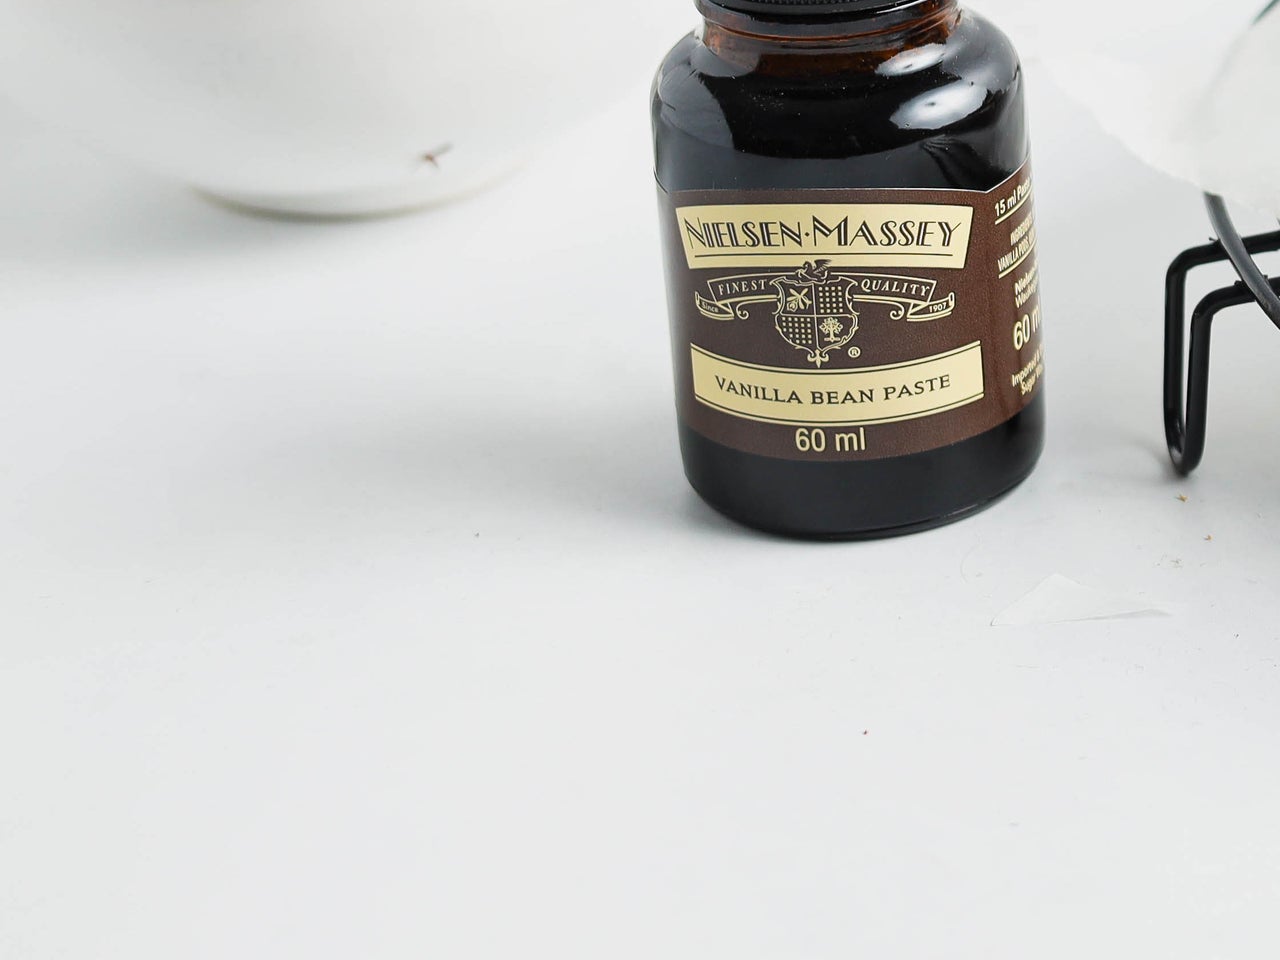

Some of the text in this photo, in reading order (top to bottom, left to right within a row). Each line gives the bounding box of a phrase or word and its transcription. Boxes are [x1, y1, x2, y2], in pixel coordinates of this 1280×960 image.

[995, 199, 1006, 217] 15
[1007, 189, 1017, 209] ml
[718, 278, 930, 297] FINEST QUALITY
[701, 301, 948, 313] Since 1907
[1013, 313, 1030, 351] 60
[715, 374, 951, 405] VANILLA BEAN PASTE
[795, 426, 866, 452] 60 ml
